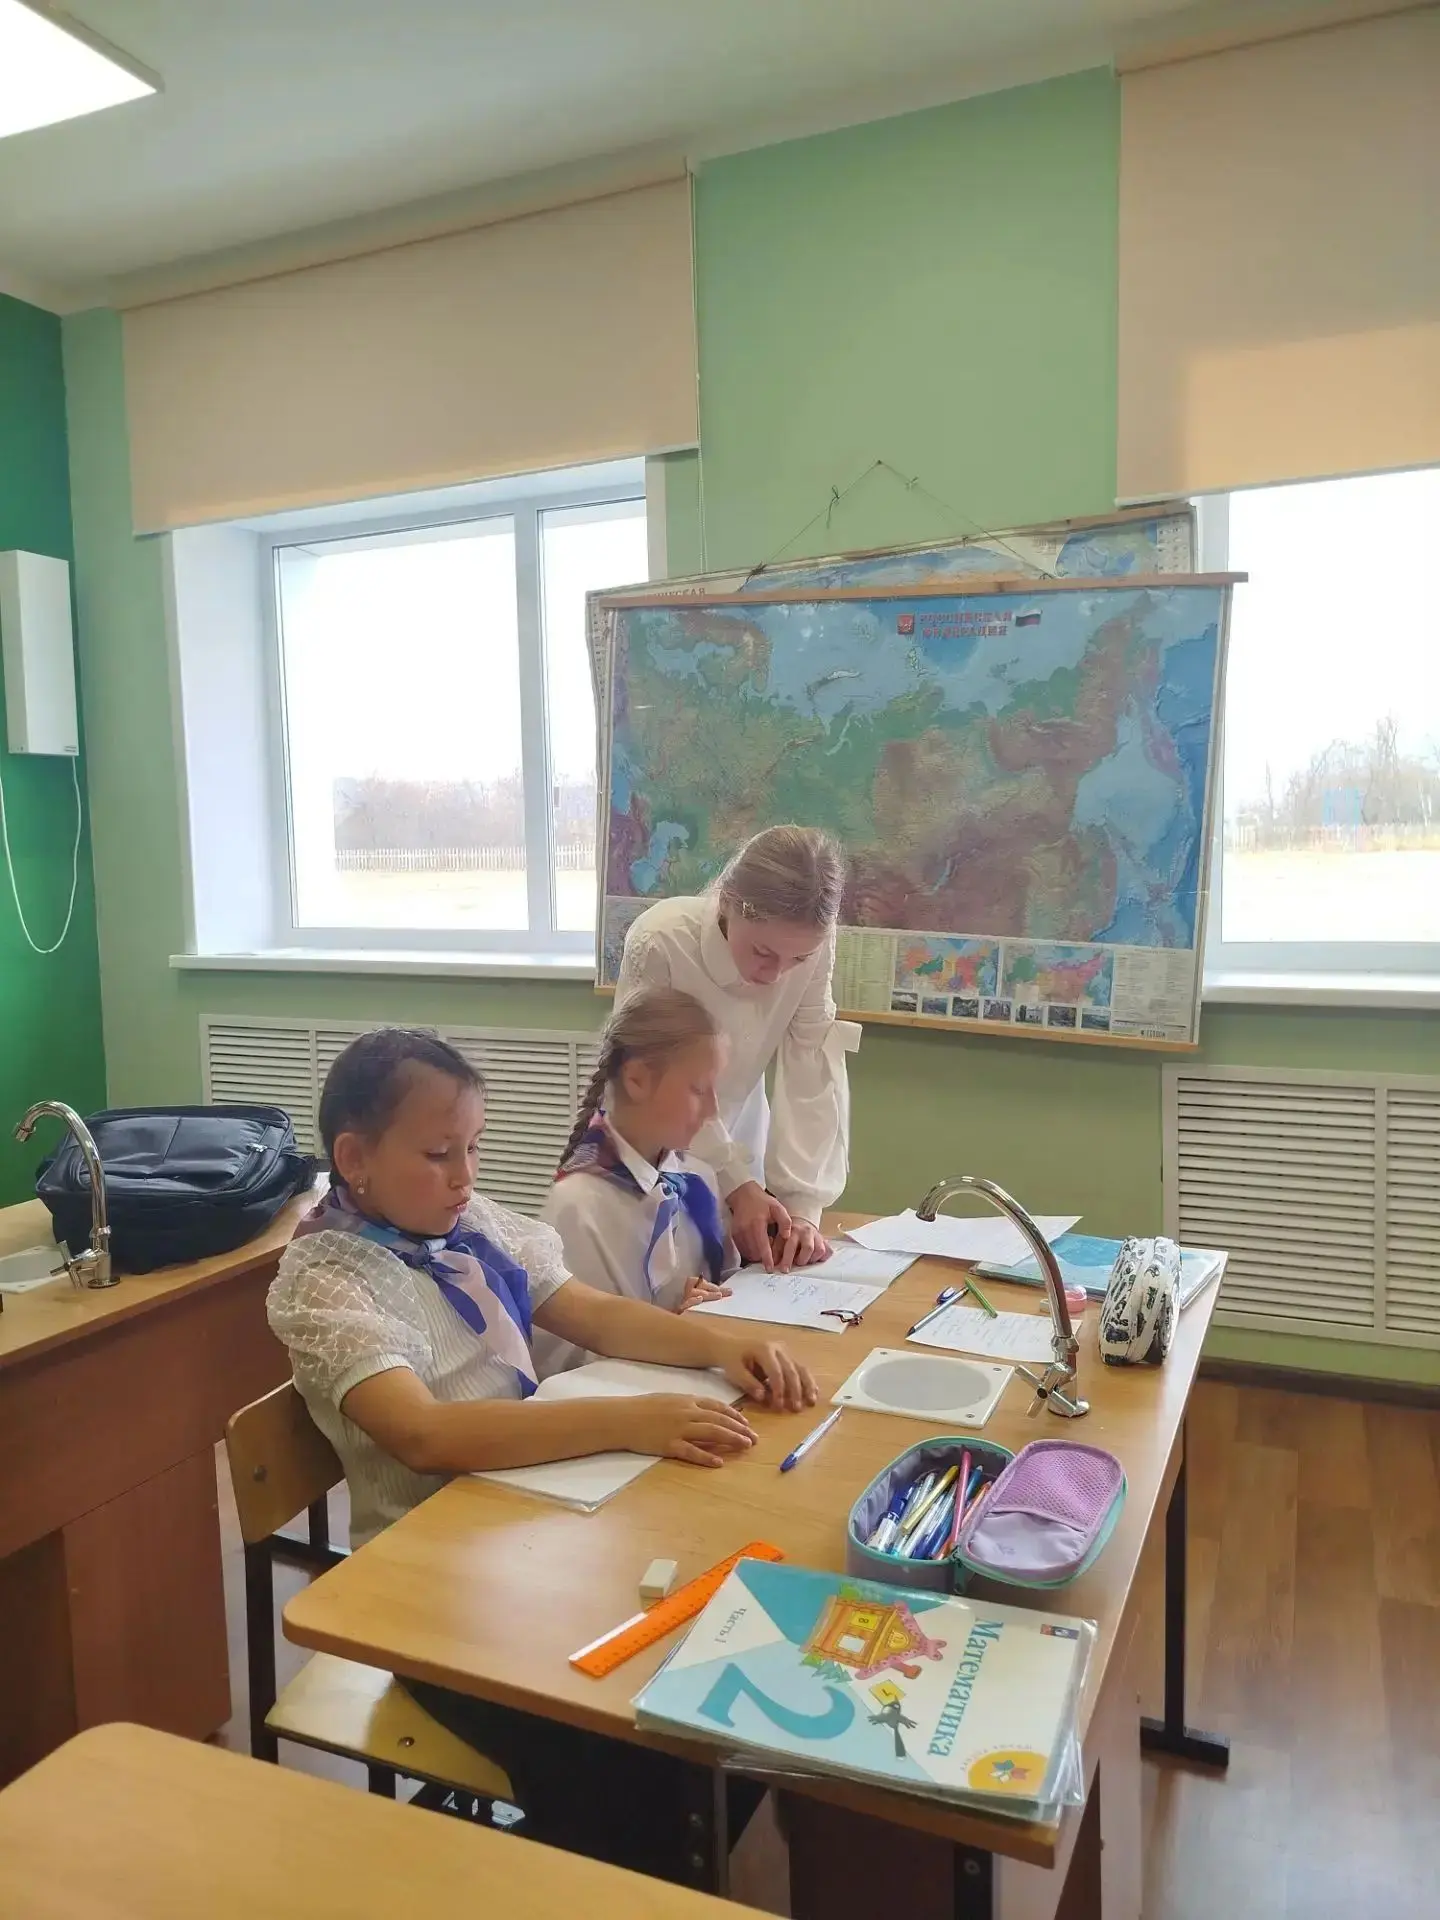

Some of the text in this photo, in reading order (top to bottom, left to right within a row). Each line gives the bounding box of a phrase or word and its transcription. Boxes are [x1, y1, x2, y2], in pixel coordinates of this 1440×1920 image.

[719, 1608, 747, 1636] Часть
[696, 1662, 855, 1740] 2
[927, 1616, 1004, 1757] Математика
